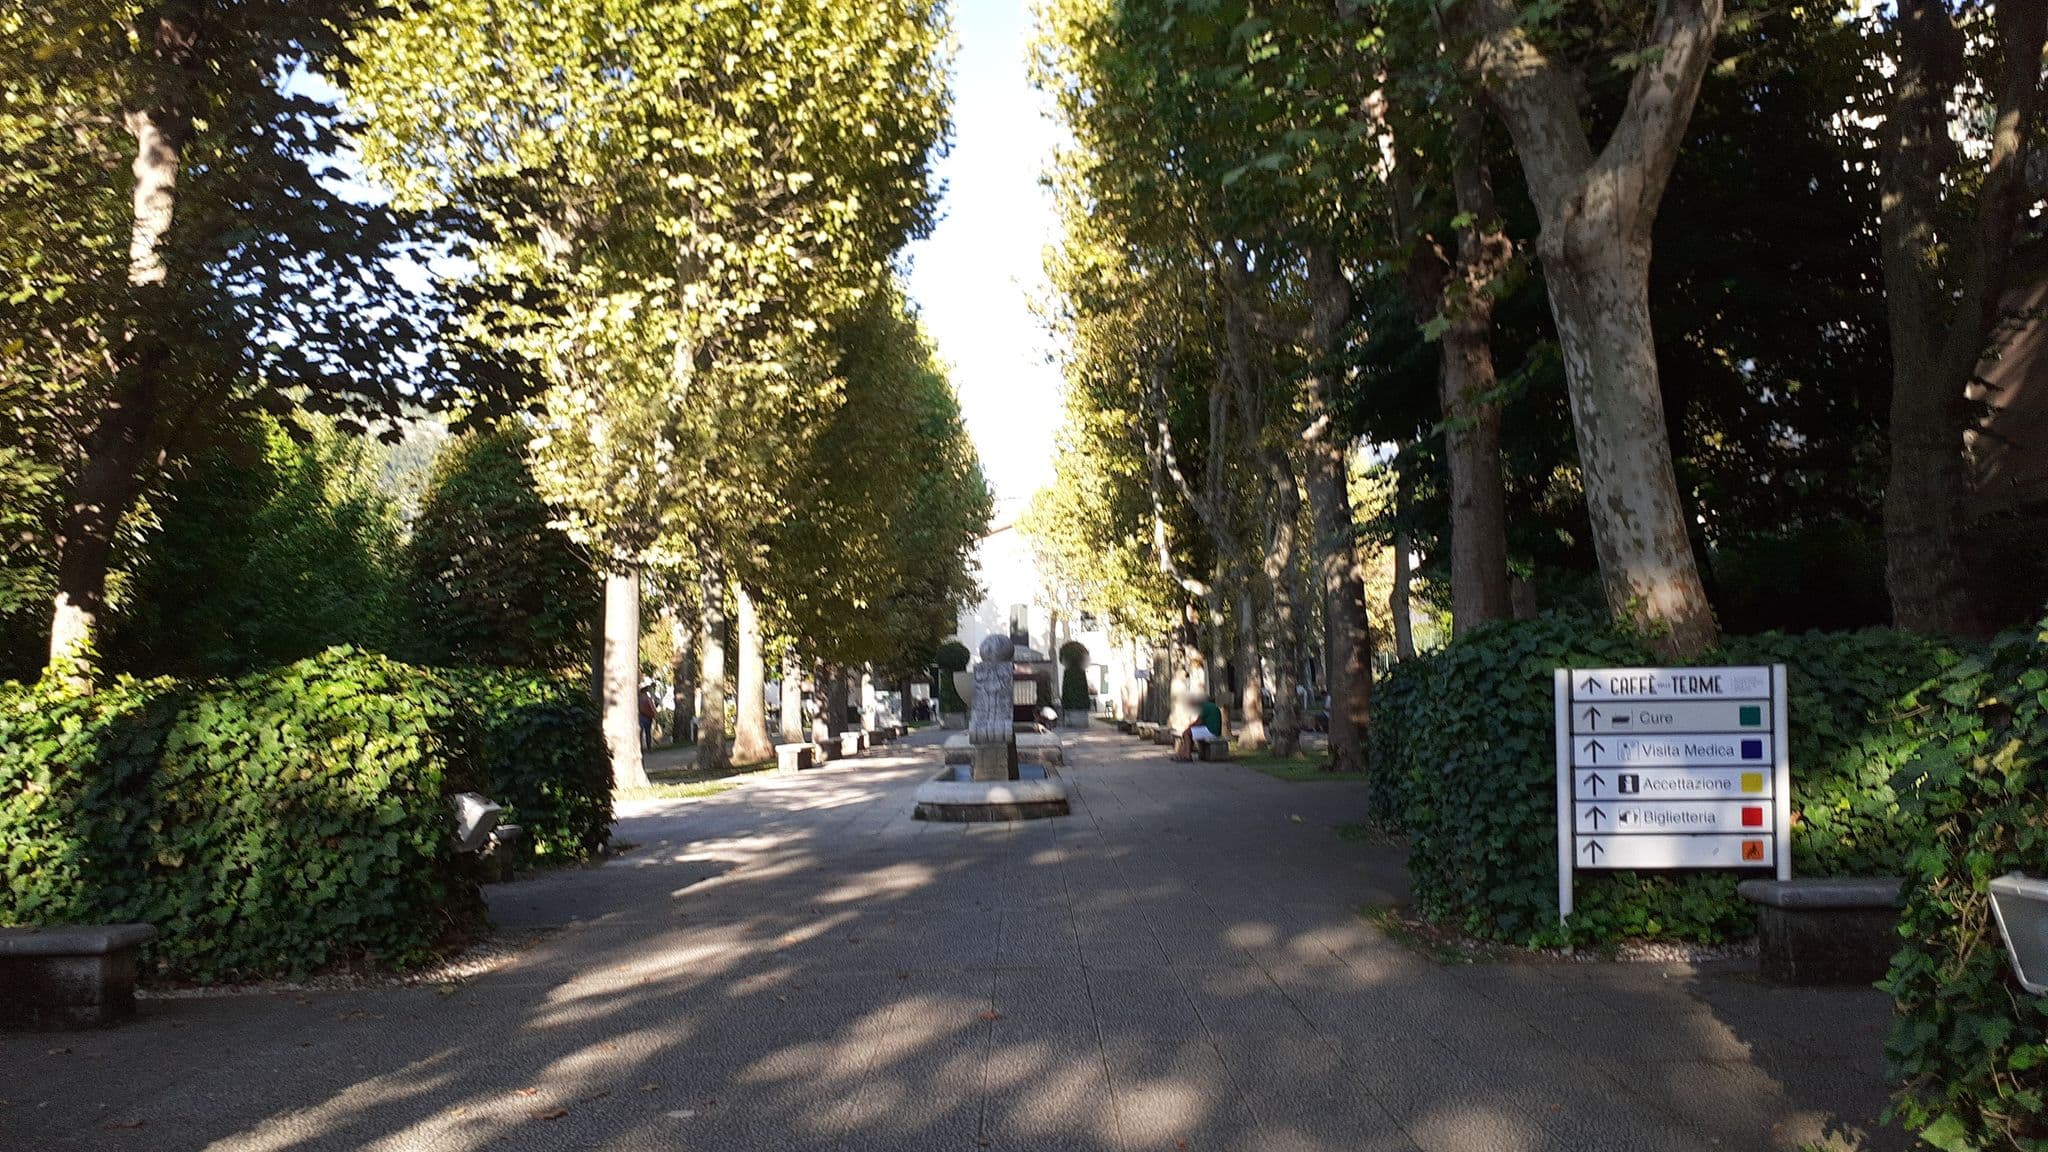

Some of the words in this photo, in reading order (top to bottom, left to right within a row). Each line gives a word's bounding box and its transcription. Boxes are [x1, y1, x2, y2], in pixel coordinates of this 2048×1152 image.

[1610, 675, 1657, 695] CAFFÈ
[1671, 675, 1723, 694] TERME
[1639, 711, 1673, 725] Cure
[1642, 743, 1680, 757] Visita
[1684, 743, 1735, 757] Medica
[1643, 776, 1732, 791] Accettazione
[1644, 809, 1716, 827] Biglietteria
